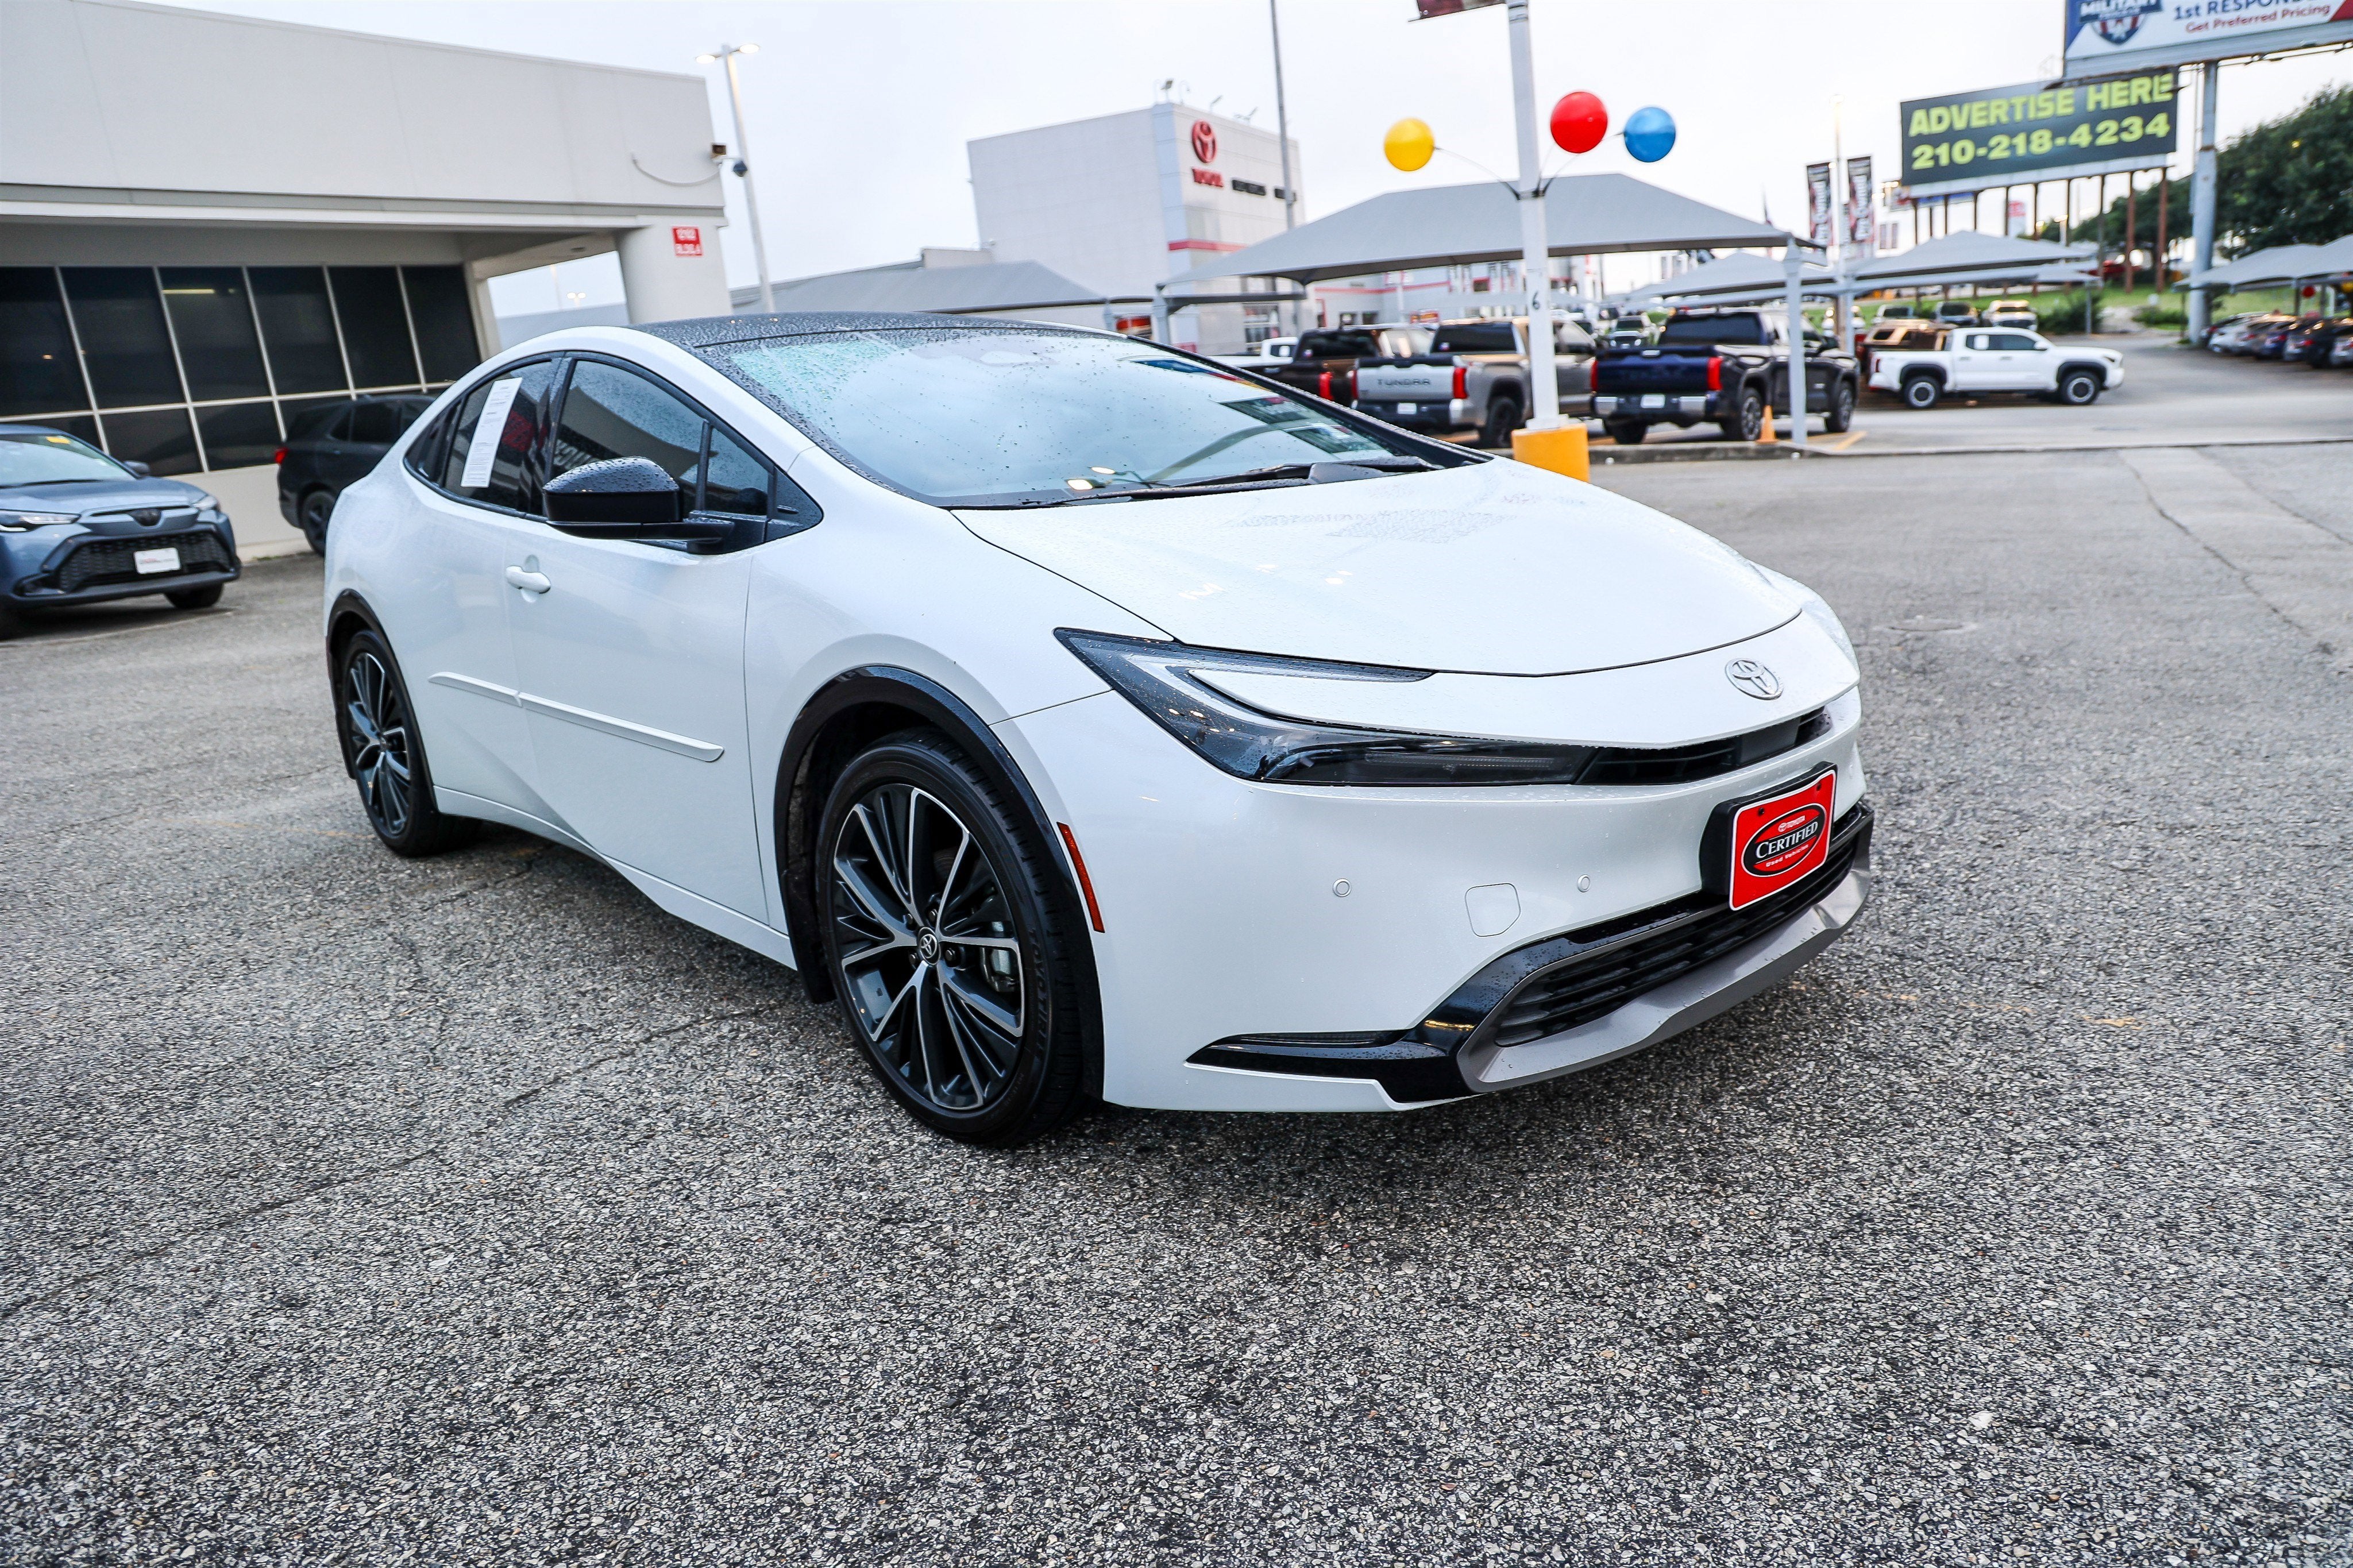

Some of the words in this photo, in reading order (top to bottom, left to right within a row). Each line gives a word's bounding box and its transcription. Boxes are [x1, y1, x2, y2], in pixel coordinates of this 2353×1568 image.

[2174, 5, 2201, 20] 1st
[2185, 21, 2209, 33] Get
[2213, 11, 2277, 29] Preferred
[2282, 5, 2331, 18] Pricing
[1908, 87, 2075, 137] ADVERTISE
[2086, 72, 2174, 112] HERE
[1912, 113, 2170, 170] 210-218-4234
[1532, 291, 1540, 310] 6
[1755, 821, 1818, 858] CERTIFIED
[1766, 857, 1783, 867] Used
